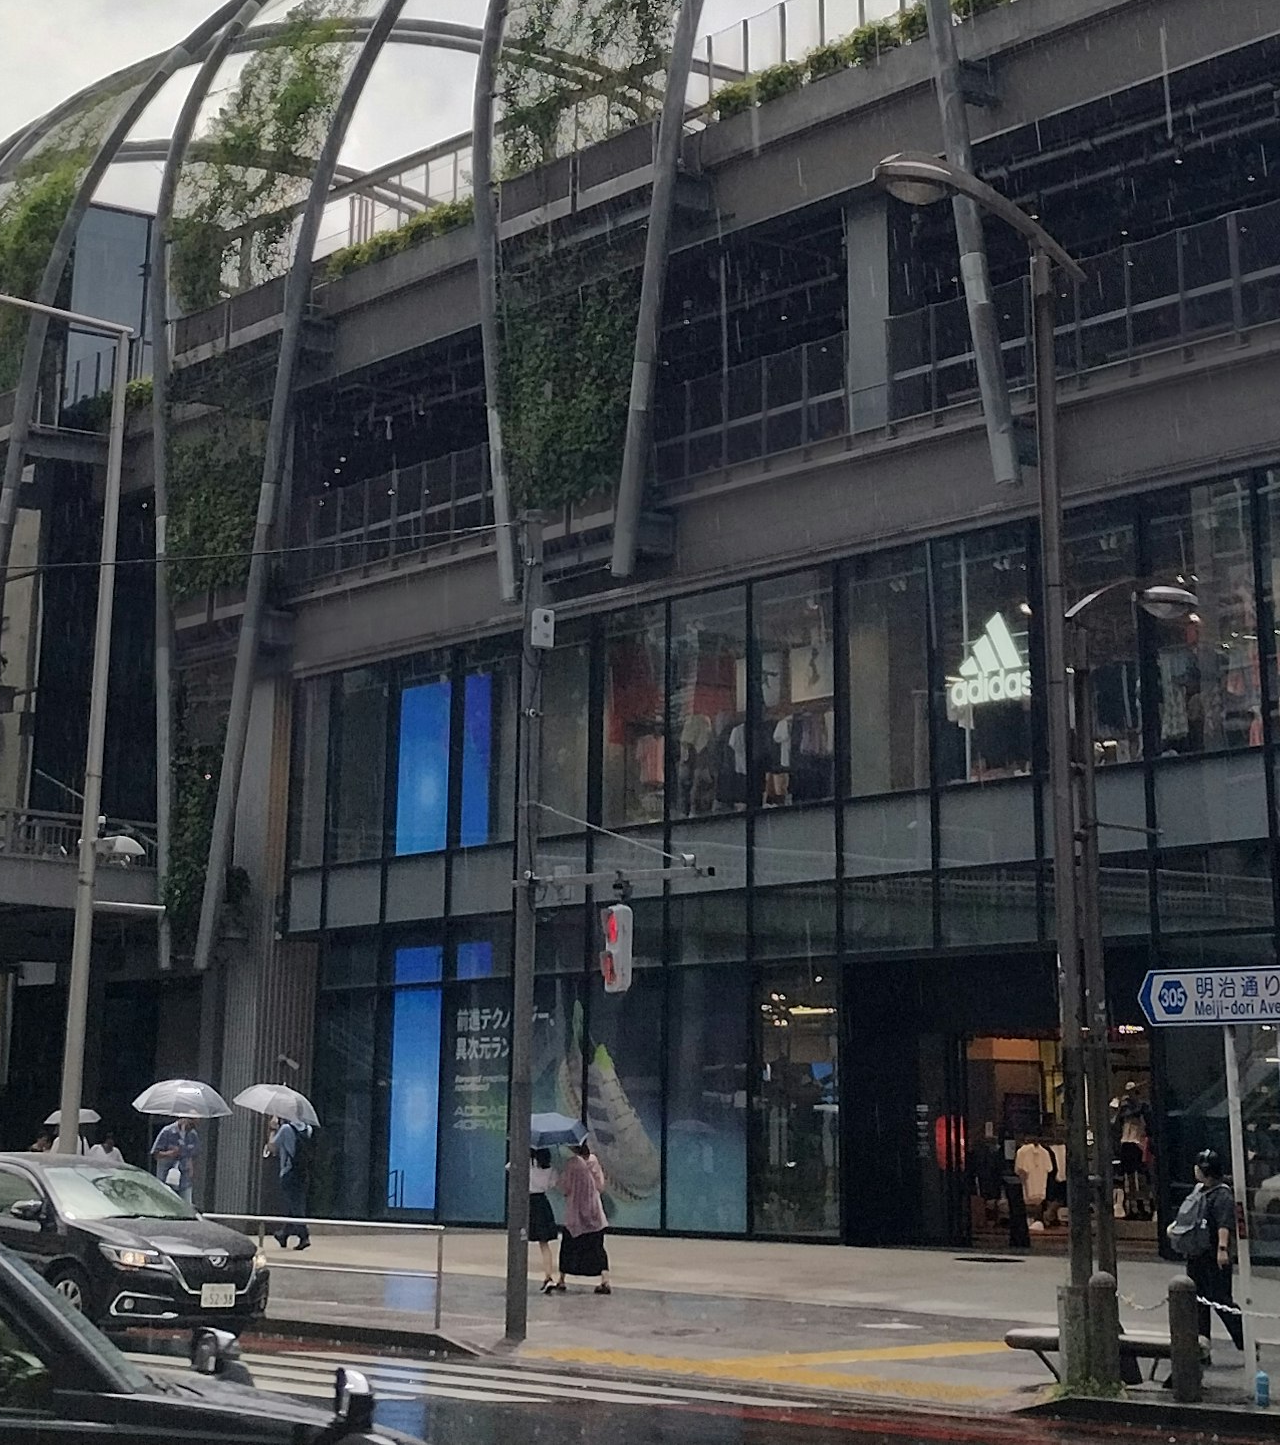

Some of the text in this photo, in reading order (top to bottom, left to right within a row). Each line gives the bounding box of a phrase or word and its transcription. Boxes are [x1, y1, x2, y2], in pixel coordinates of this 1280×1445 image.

[951, 667, 1032, 706] adidas
[1160, 975, 1280, 1007] 305 明治通り
[1195, 1000, 1255, 1018] Meiji-dori
